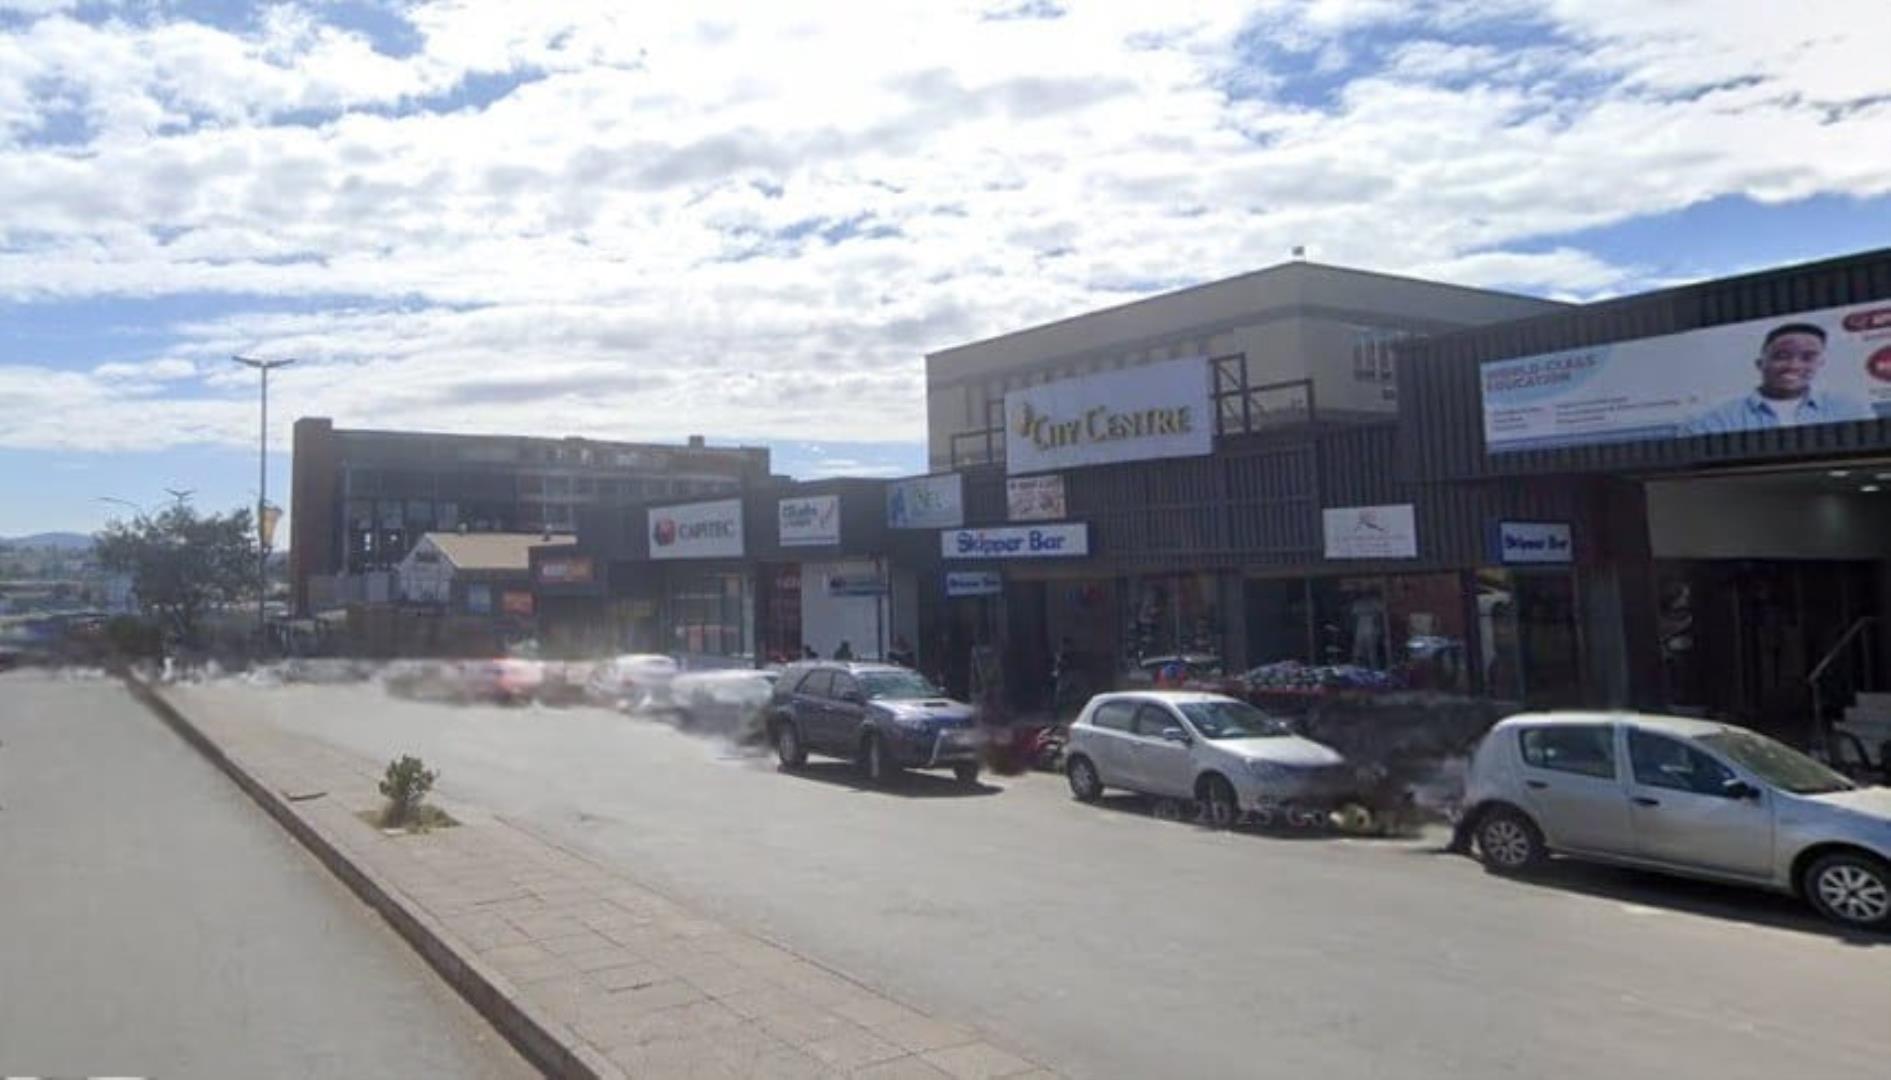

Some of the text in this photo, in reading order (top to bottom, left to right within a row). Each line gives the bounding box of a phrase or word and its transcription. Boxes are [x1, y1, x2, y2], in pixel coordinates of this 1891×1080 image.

[1031, 405, 1193, 451] CITY CENTRE
[678, 518, 736, 540] CAPITEC
[956, 529, 1066, 553] Skipper Bar
